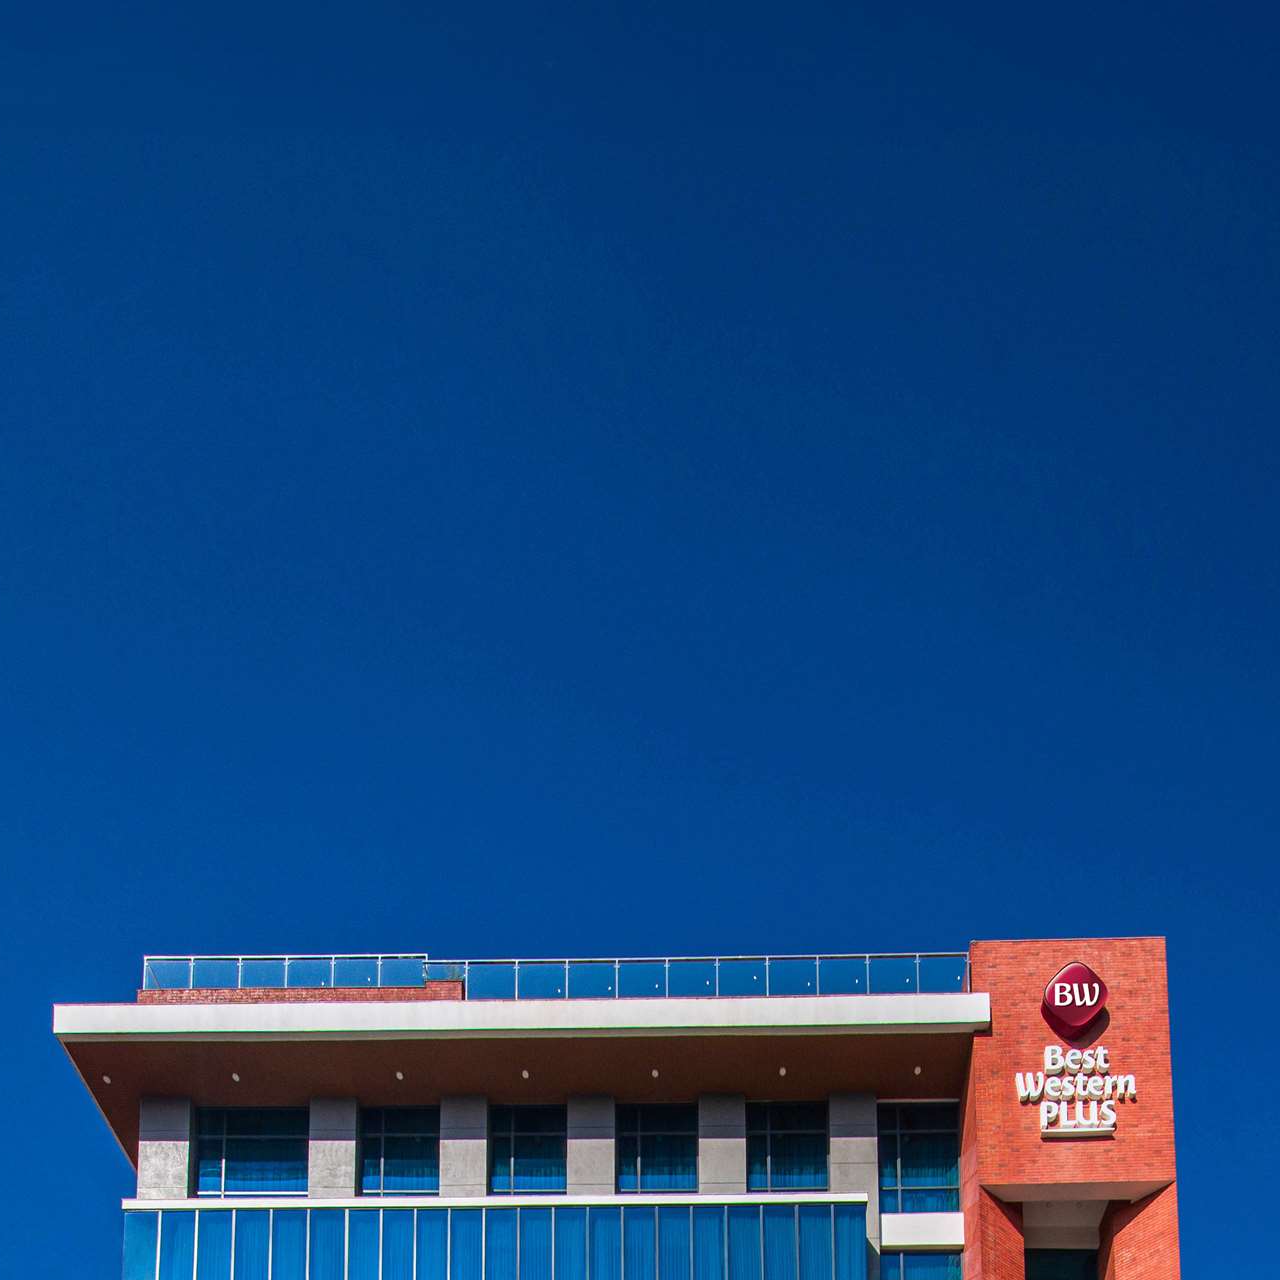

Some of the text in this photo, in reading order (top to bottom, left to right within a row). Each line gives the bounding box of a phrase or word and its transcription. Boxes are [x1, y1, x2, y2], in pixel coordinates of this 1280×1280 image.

[1053, 982, 1100, 1007] BW
[1043, 1045, 1110, 1075] Best
[1015, 1071, 1136, 1101] Western
[1040, 1100, 1117, 1129] PLUS
